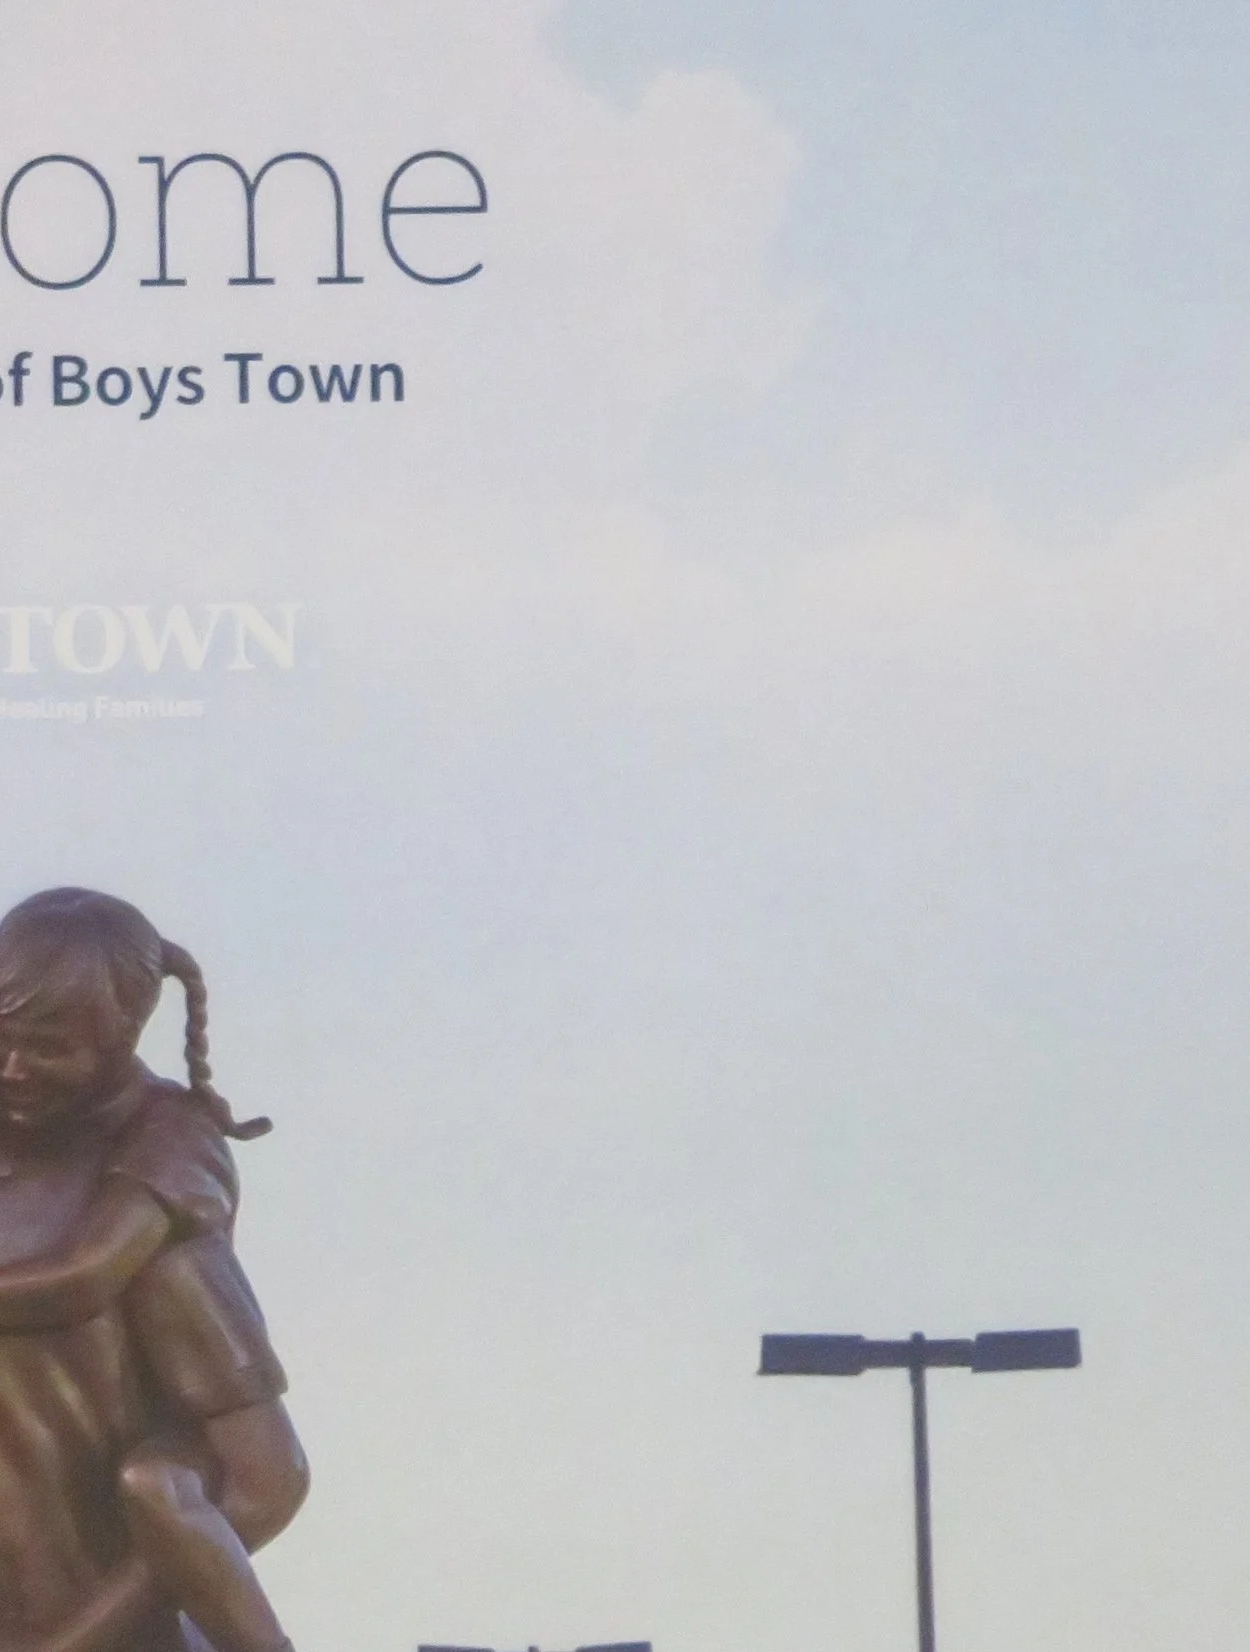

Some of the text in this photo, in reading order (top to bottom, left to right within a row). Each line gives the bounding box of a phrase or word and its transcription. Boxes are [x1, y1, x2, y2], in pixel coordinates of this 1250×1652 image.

[51, 352, 206, 421] Boys
[223, 352, 406, 405] Town
[95, 694, 206, 719] Families
